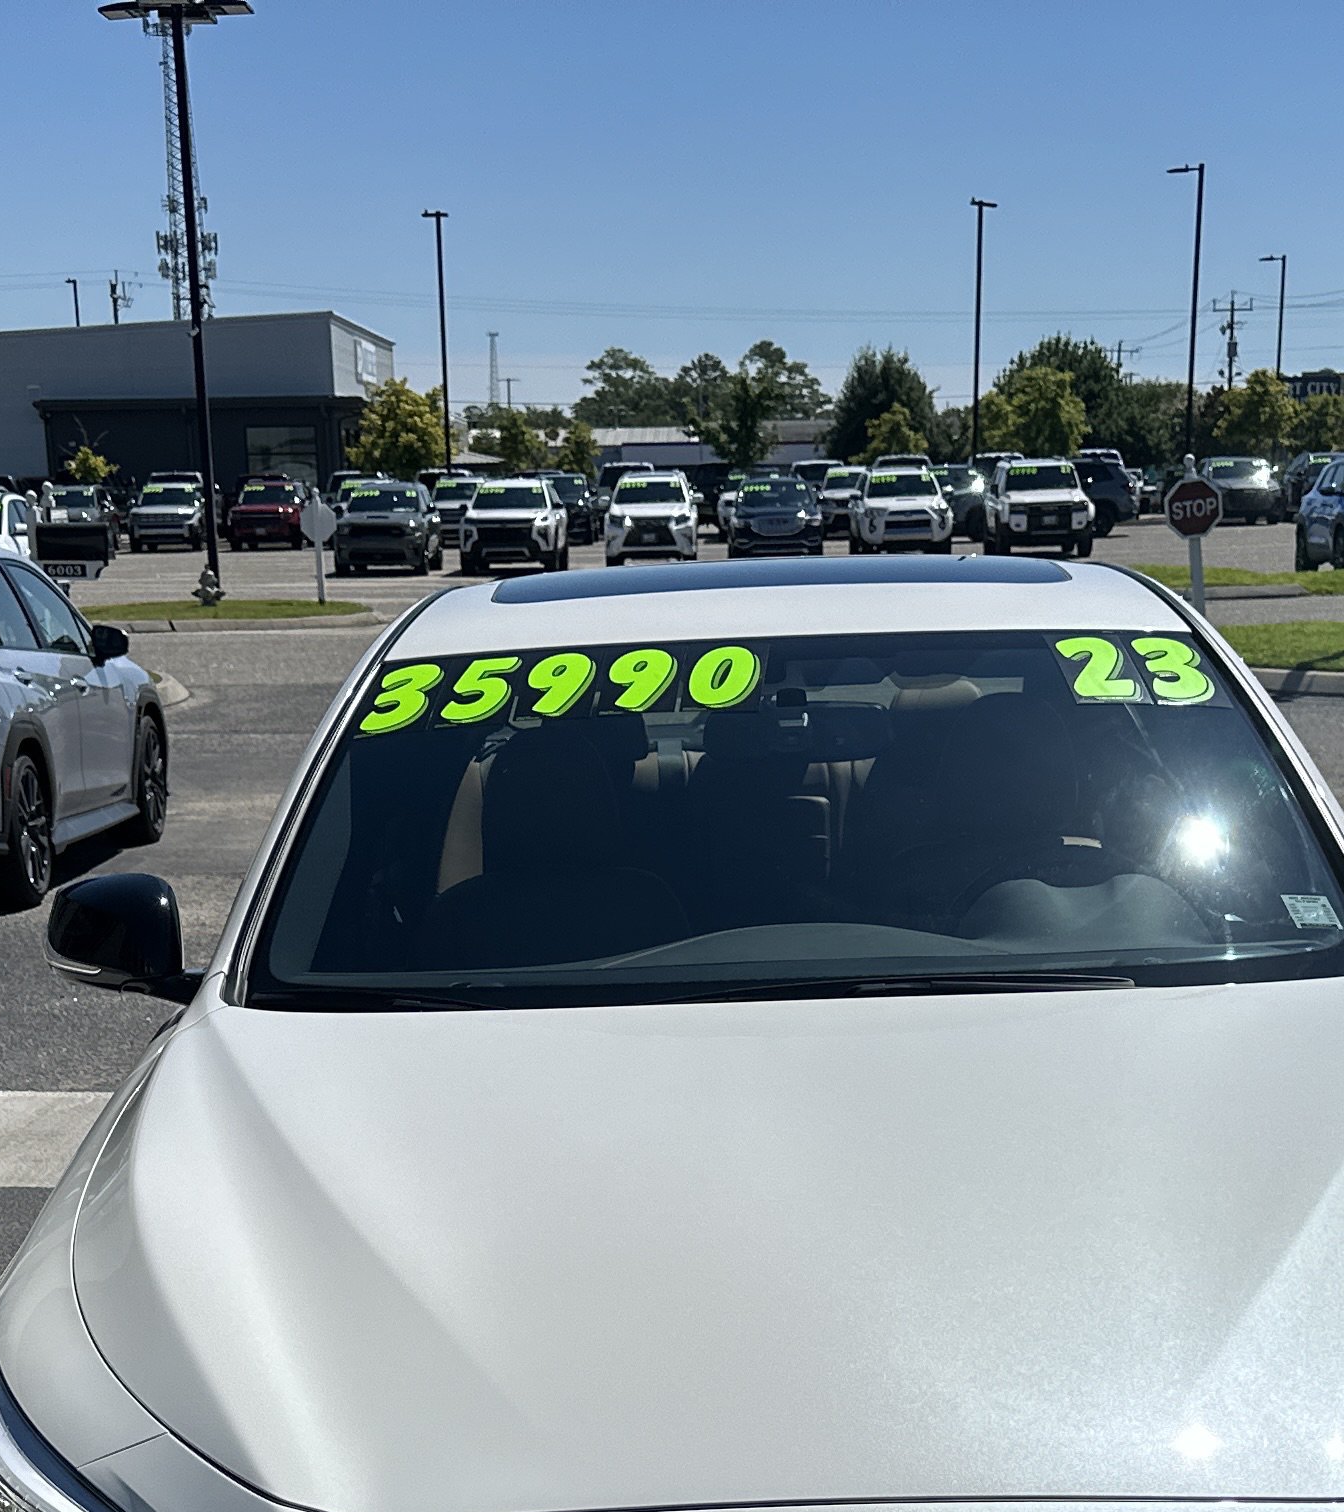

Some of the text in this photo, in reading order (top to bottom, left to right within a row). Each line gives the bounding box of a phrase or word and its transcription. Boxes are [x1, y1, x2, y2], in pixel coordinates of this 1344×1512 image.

[1172, 498, 1217, 520] STOP
[48, 565, 82, 576] 6003
[359, 637, 1215, 734] 35990 23
